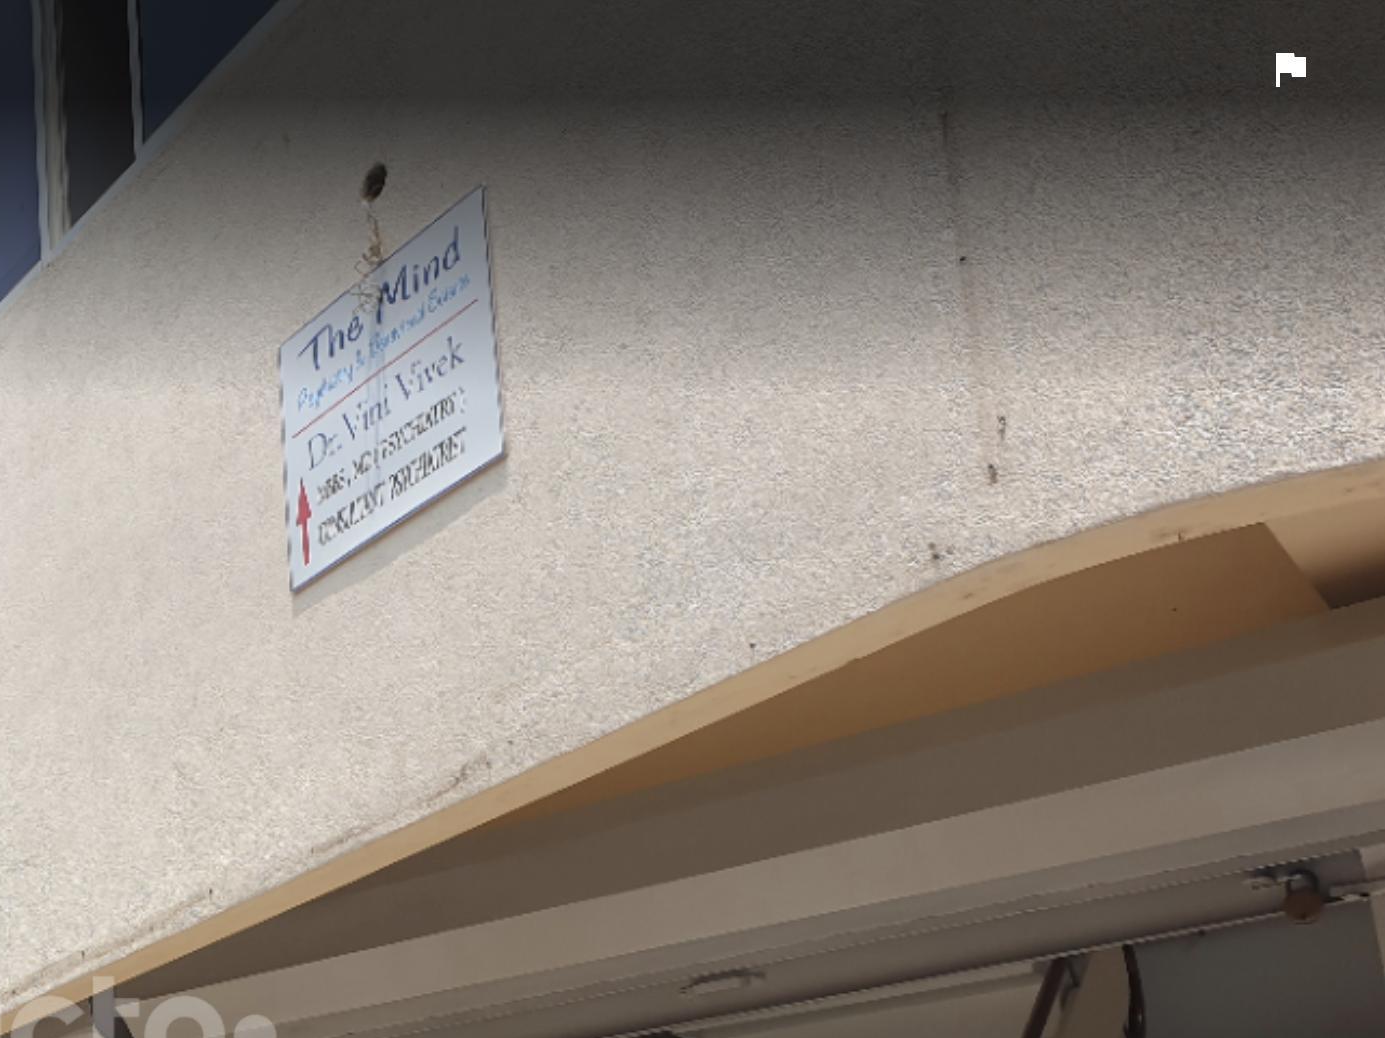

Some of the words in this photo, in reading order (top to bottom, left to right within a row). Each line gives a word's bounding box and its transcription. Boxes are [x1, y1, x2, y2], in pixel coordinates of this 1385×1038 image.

[297, 314, 364, 371] The
[376, 225, 461, 325] Mind
[395, 335, 464, 401] Vivek
